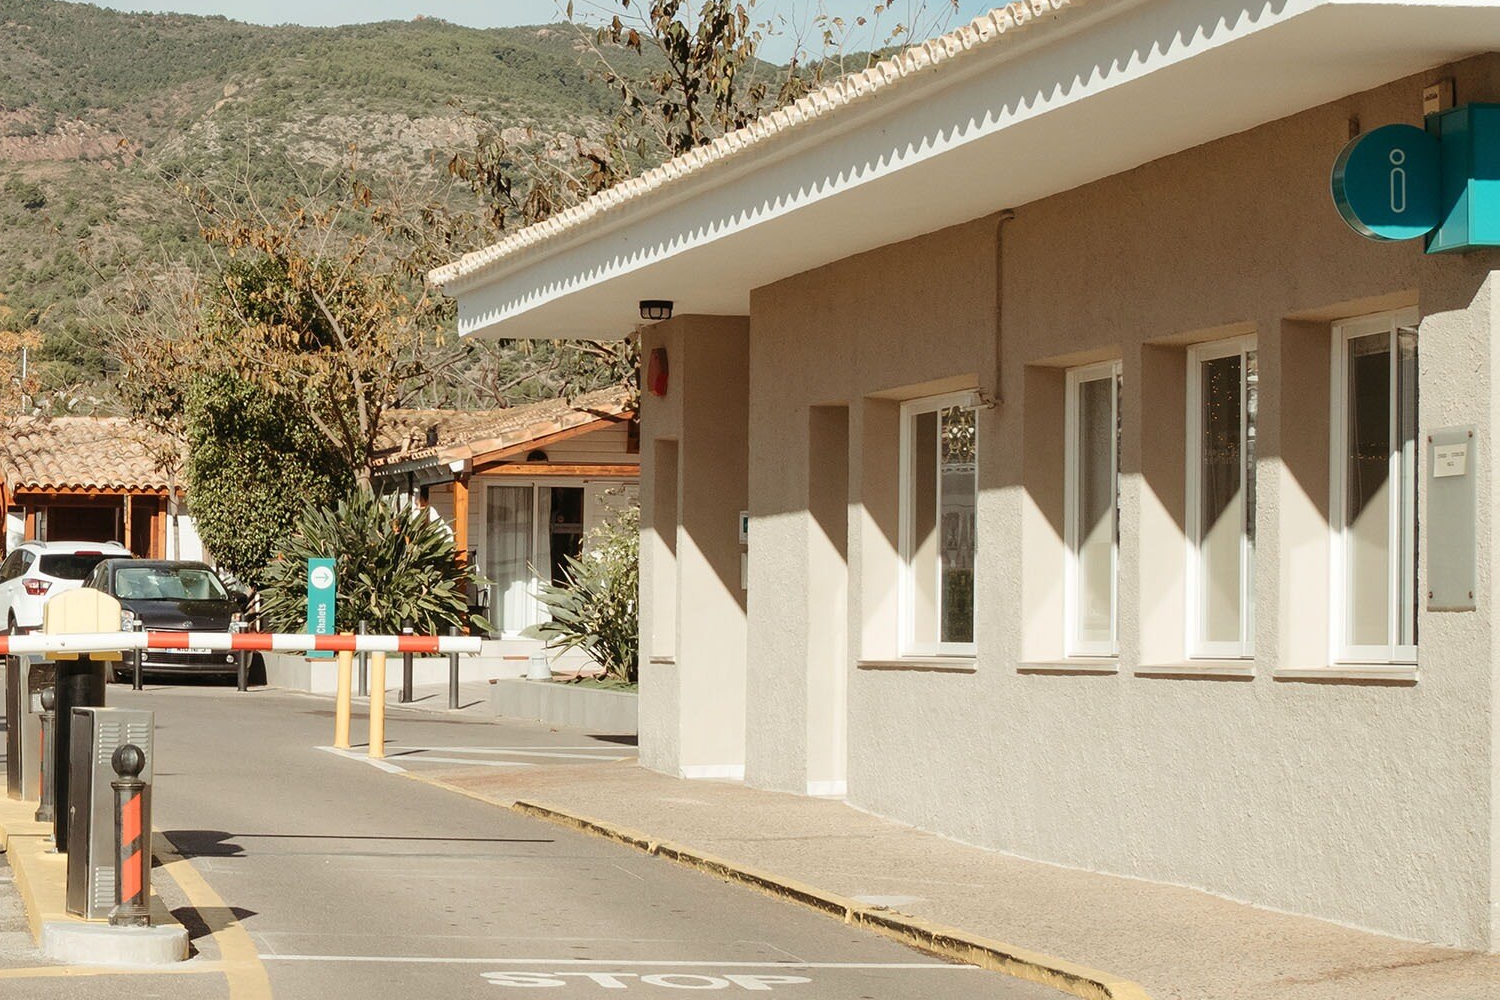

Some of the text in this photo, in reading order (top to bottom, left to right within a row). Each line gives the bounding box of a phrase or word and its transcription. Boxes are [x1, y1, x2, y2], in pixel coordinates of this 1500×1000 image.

[1389, 148, 1406, 213] i
[316, 603, 327, 634] Chalets
[479, 971, 813, 991] STOP
